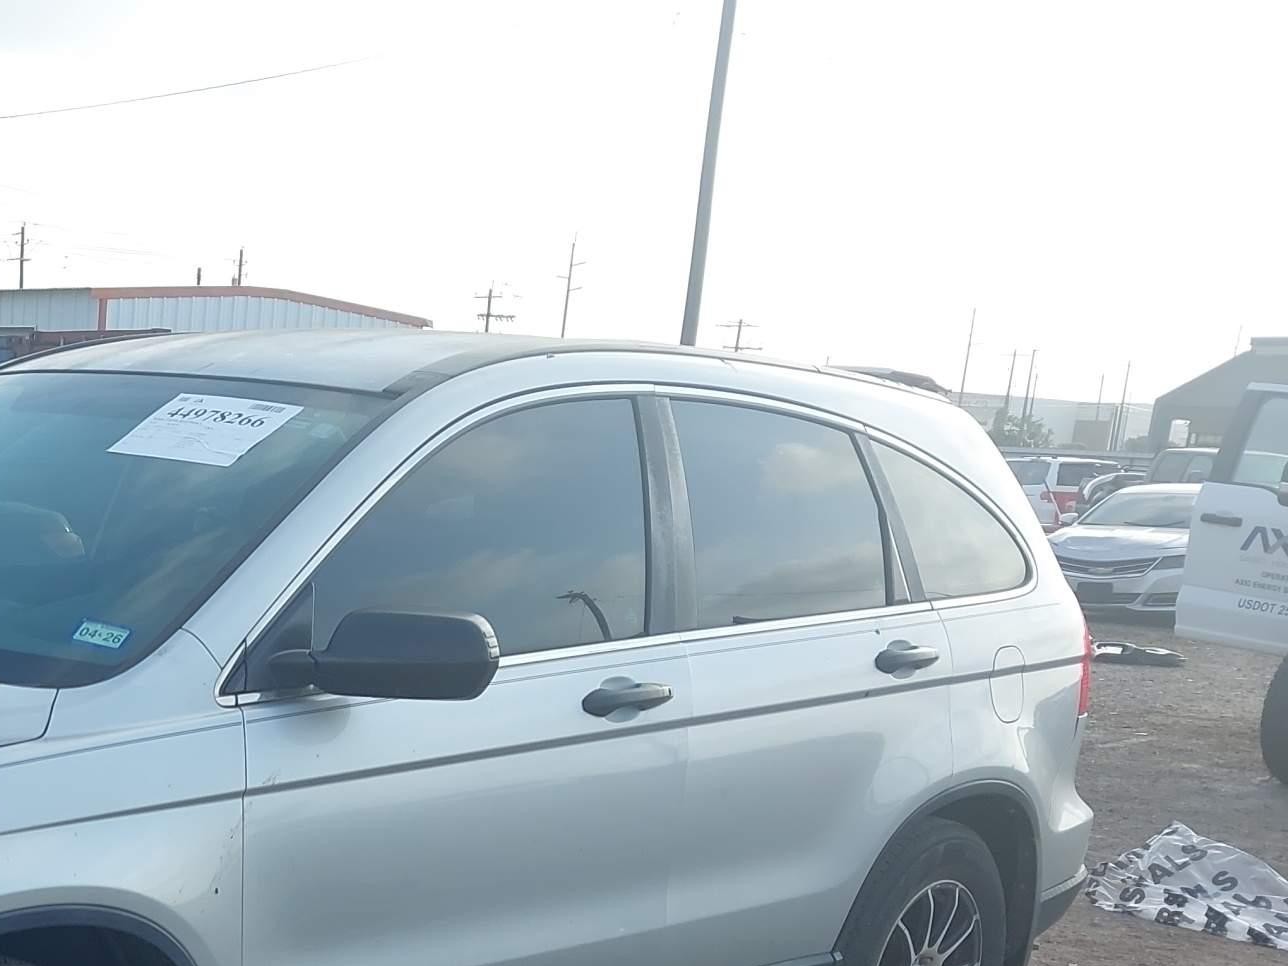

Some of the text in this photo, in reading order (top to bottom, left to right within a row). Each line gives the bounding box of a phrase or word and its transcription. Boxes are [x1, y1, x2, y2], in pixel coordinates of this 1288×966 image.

[167, 406, 270, 428] 44978266
[1238, 598, 1277, 613] USDOT
[79, 627, 124, 644] 04 26
